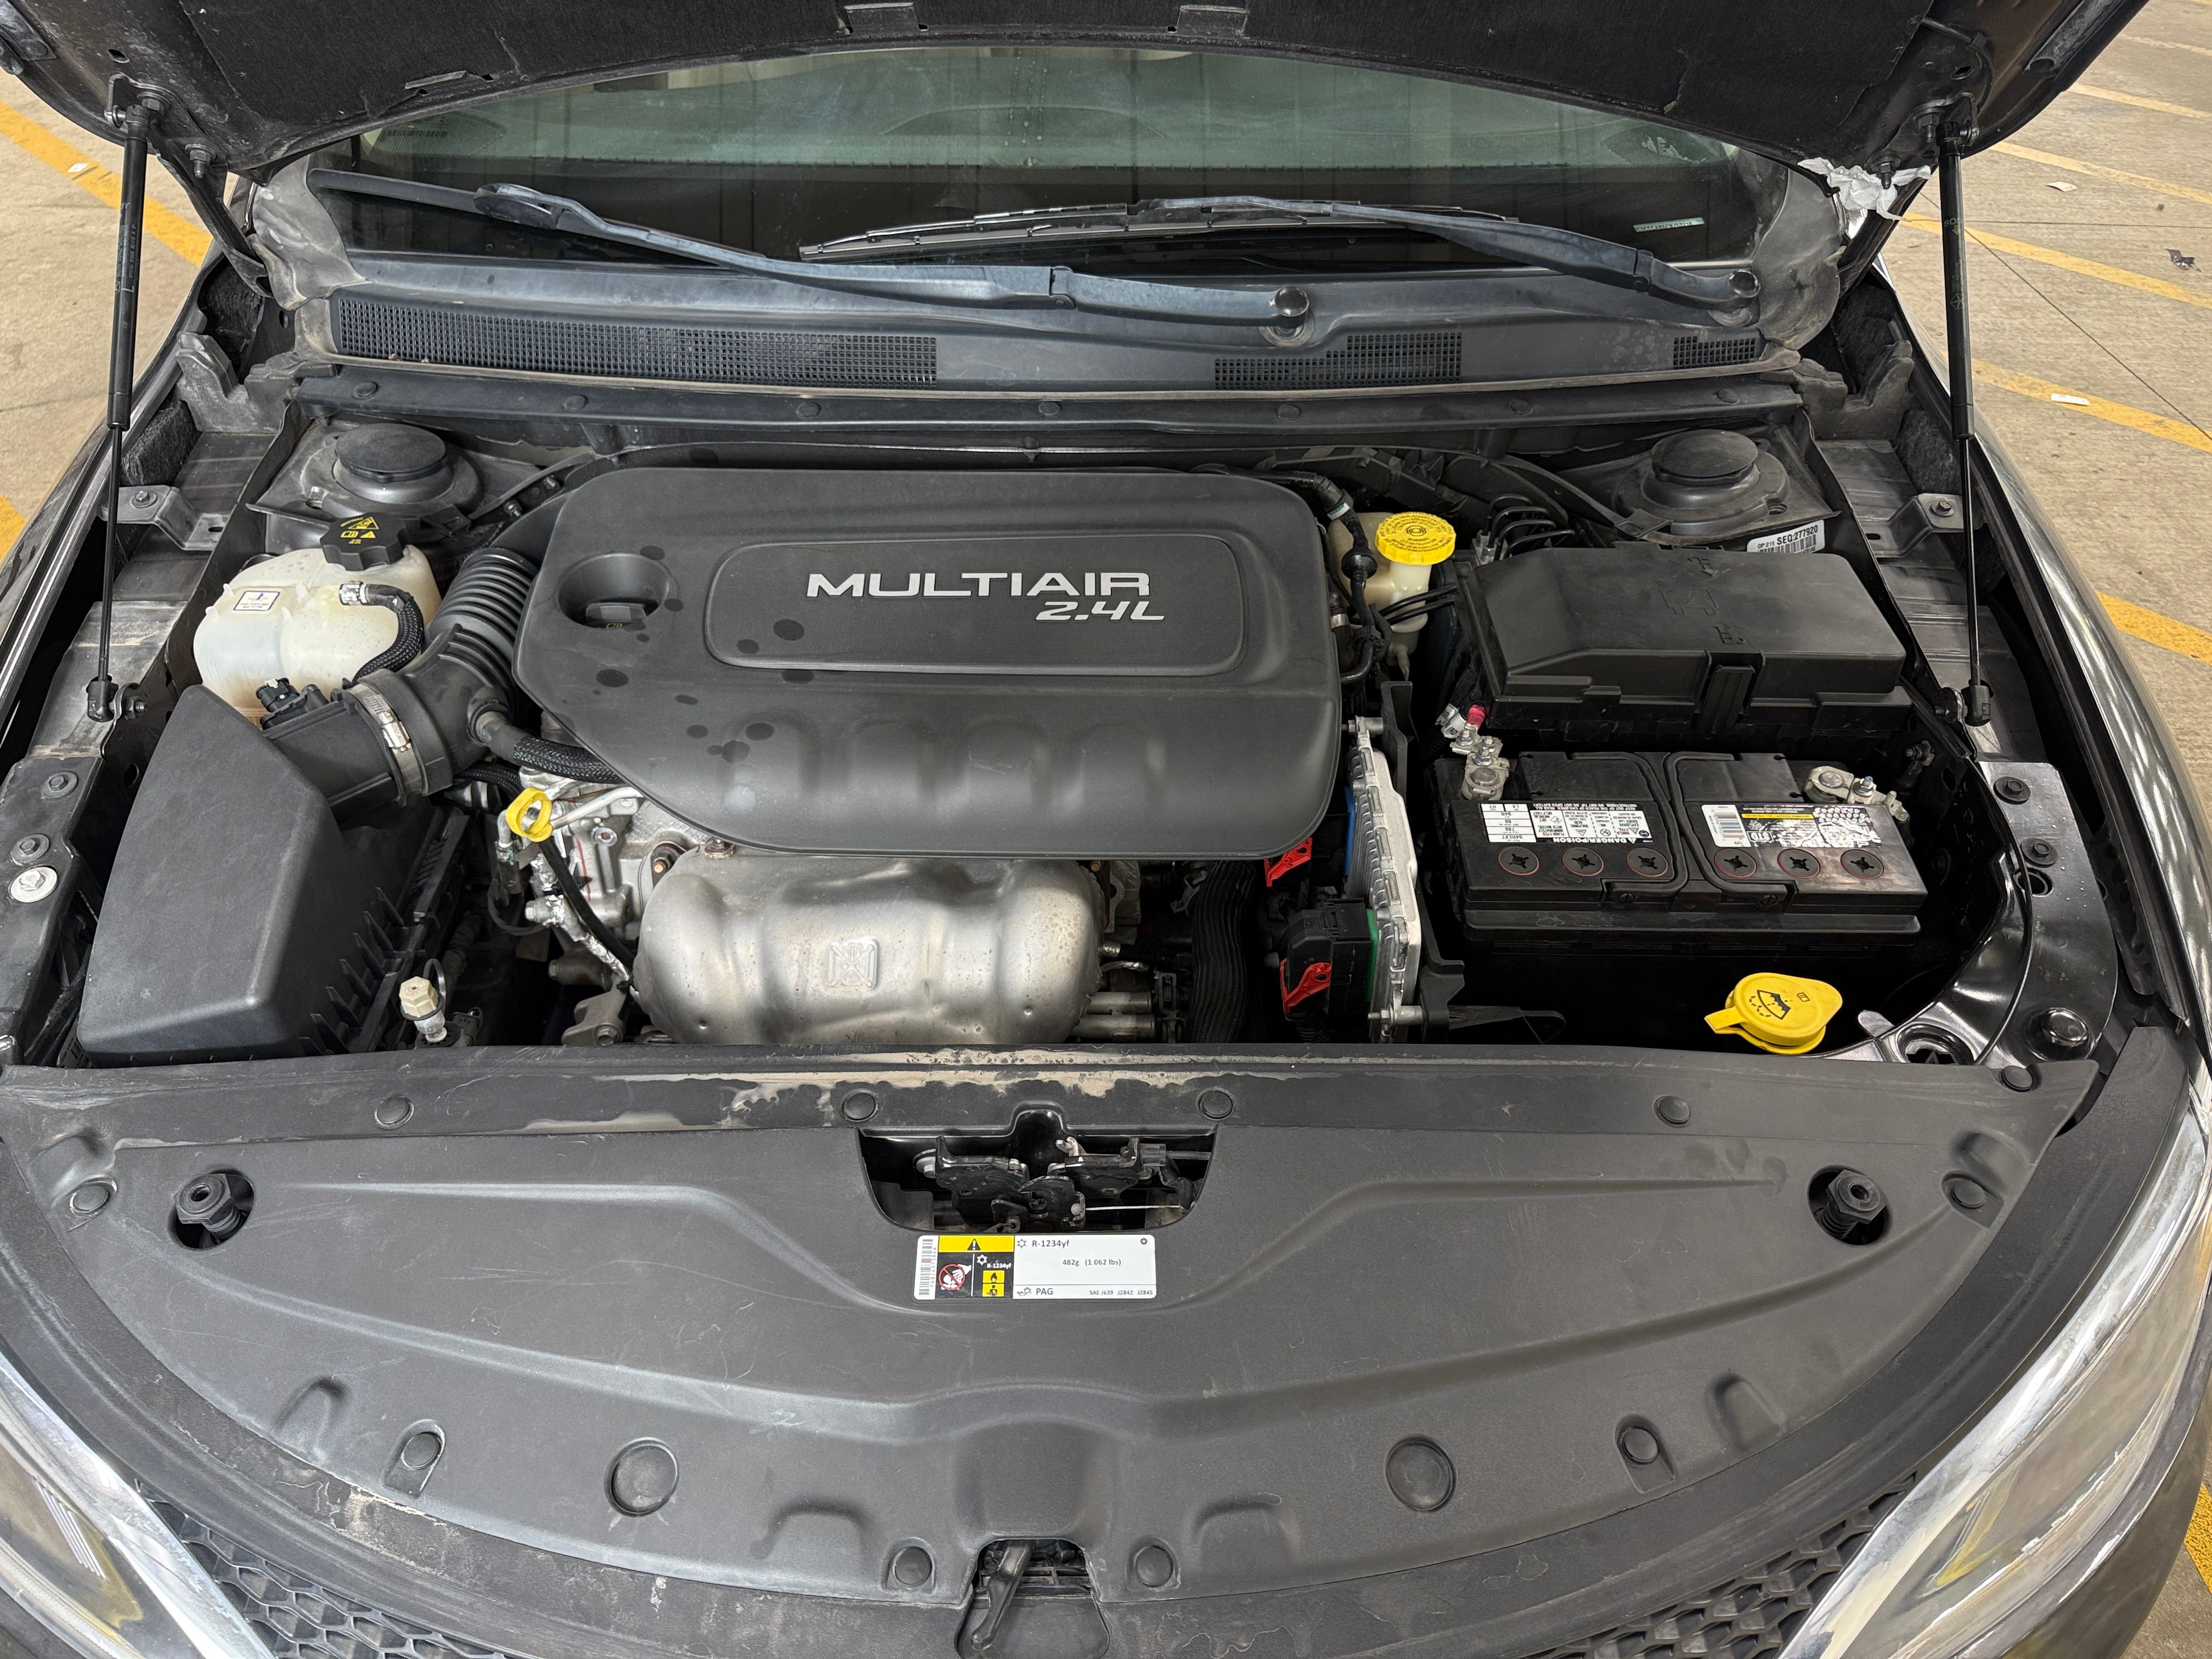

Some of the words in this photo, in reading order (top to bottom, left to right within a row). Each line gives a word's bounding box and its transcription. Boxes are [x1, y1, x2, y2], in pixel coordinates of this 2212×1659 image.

[1776, 524, 1818, 545] SEQ:277920
[806, 572, 1150, 597] MULTIAIR
[1035, 600, 1166, 621] 2.4L
[1031, 1239, 1069, 1249] R-1234yf
[1062, 1258, 1080, 1267] 482g
[1085, 1258, 1107, 1267] (1.062
[1108, 1258, 1121, 1267] lbs)
[1035, 1287, 1053, 1296] PAG
